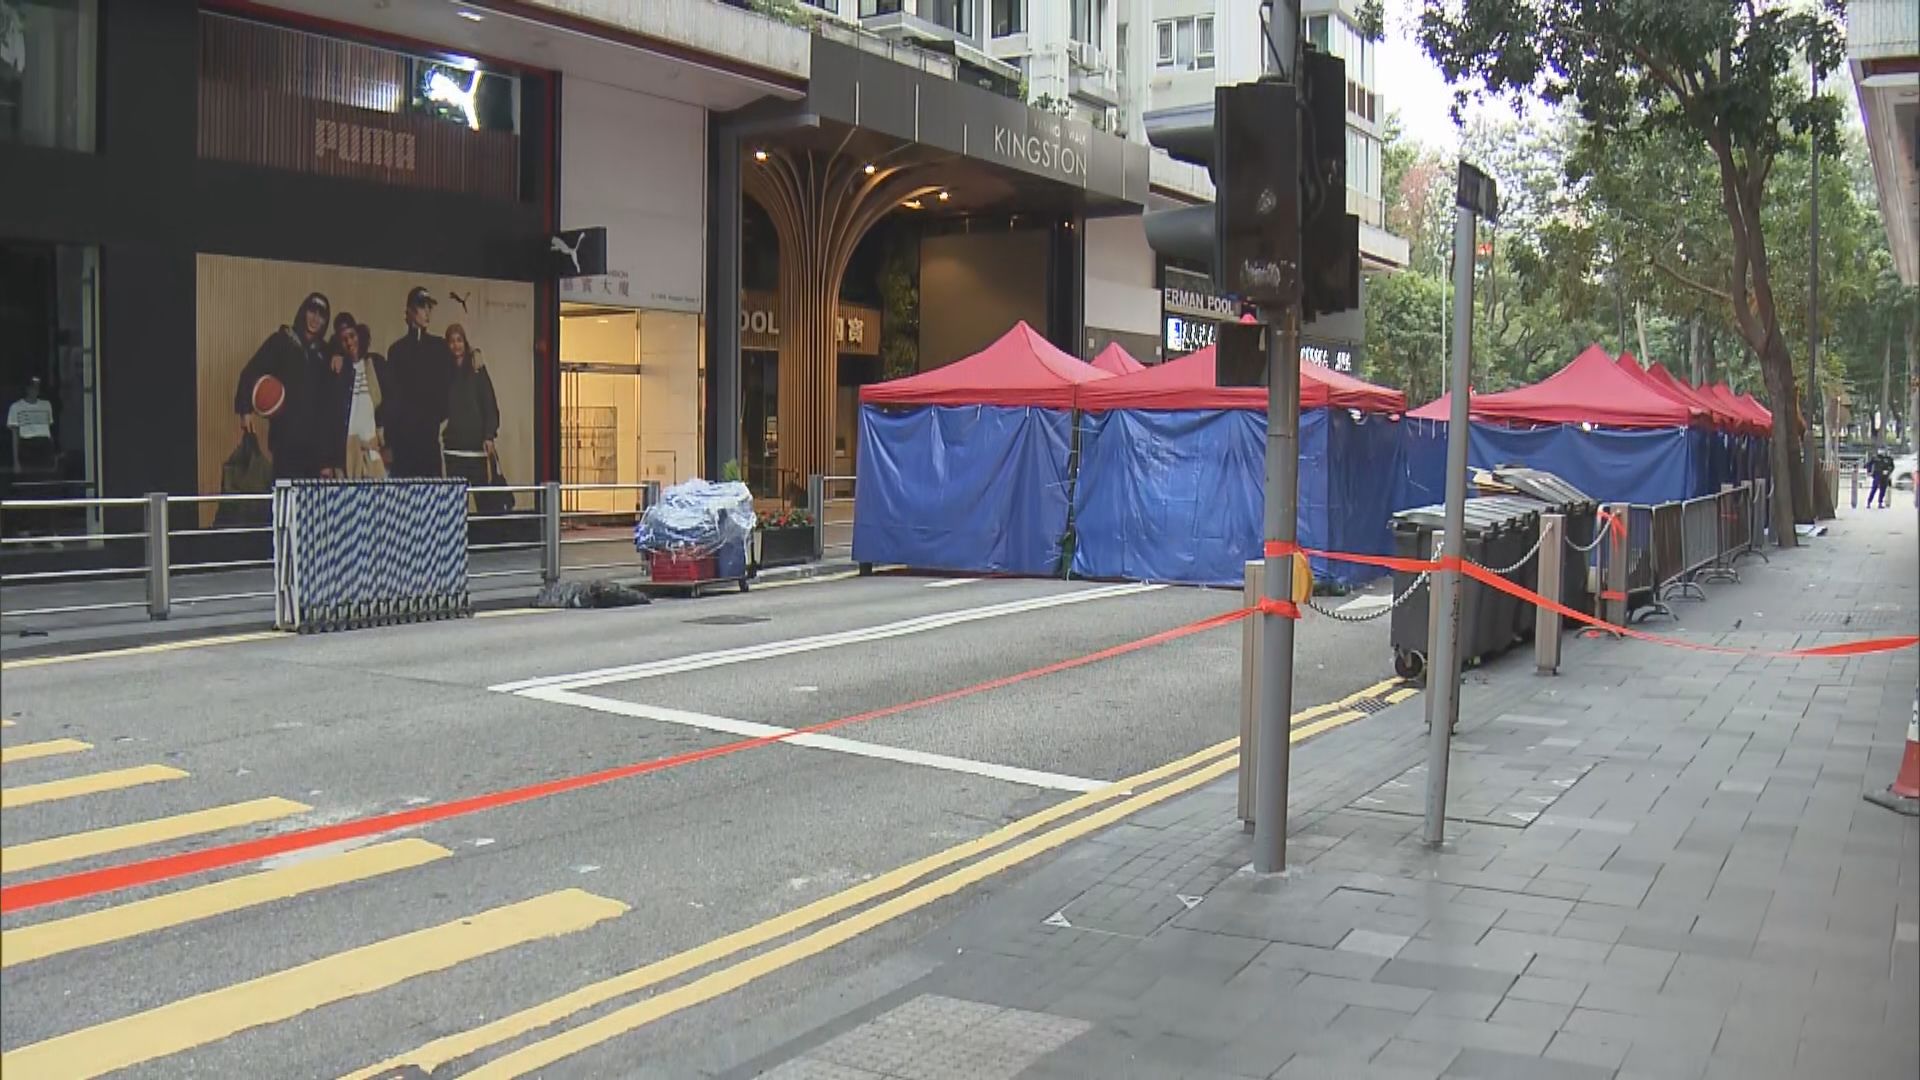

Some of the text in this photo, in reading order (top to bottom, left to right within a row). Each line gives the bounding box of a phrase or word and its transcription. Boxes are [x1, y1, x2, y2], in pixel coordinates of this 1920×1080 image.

[315, 118, 415, 170] PUMA
[994, 124, 1087, 176] KINGSTON
[1165, 288, 1234, 315] ERMAN POOL
[741, 310, 780, 335] OOL
